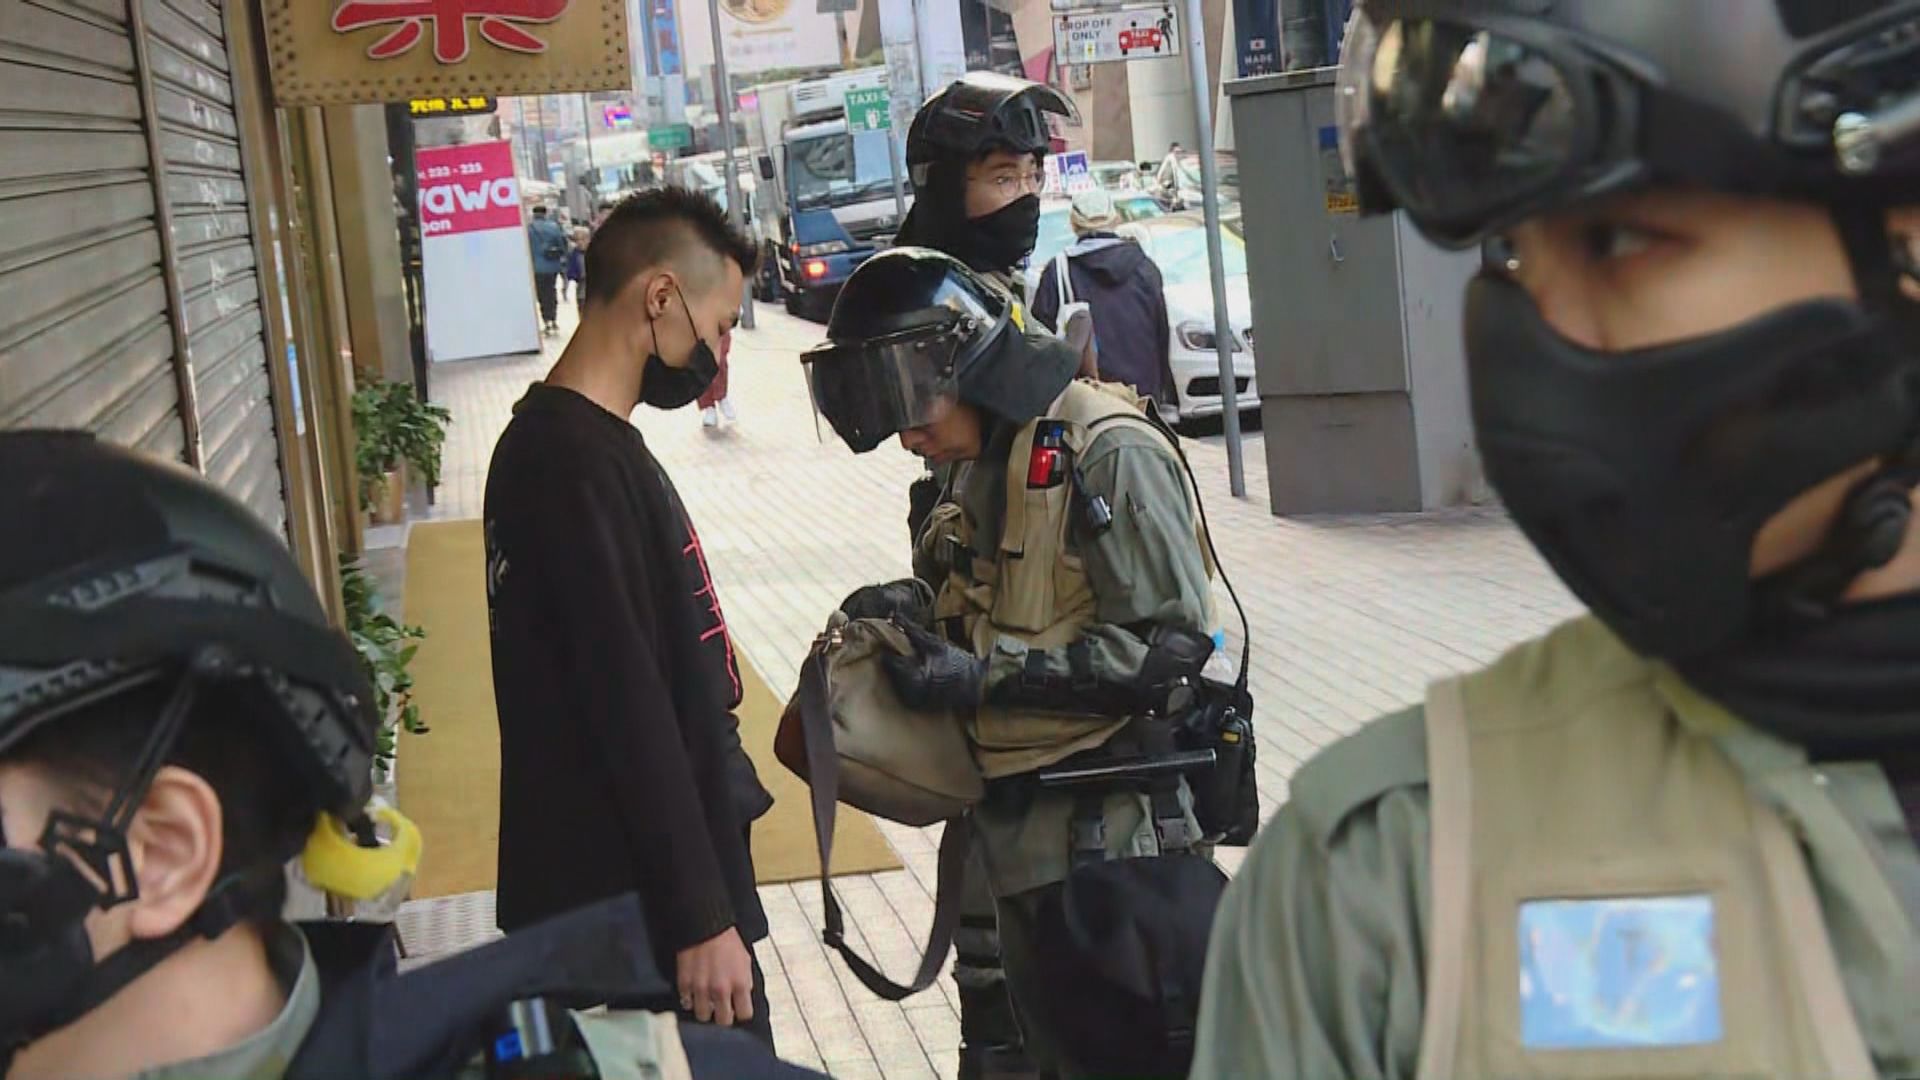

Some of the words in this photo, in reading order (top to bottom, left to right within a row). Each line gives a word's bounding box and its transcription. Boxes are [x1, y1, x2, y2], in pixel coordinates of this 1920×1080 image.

[1092, 18, 1113, 29] OFF
[1071, 31, 1102, 41] ONLY
[848, 92, 878, 104] TAXI
